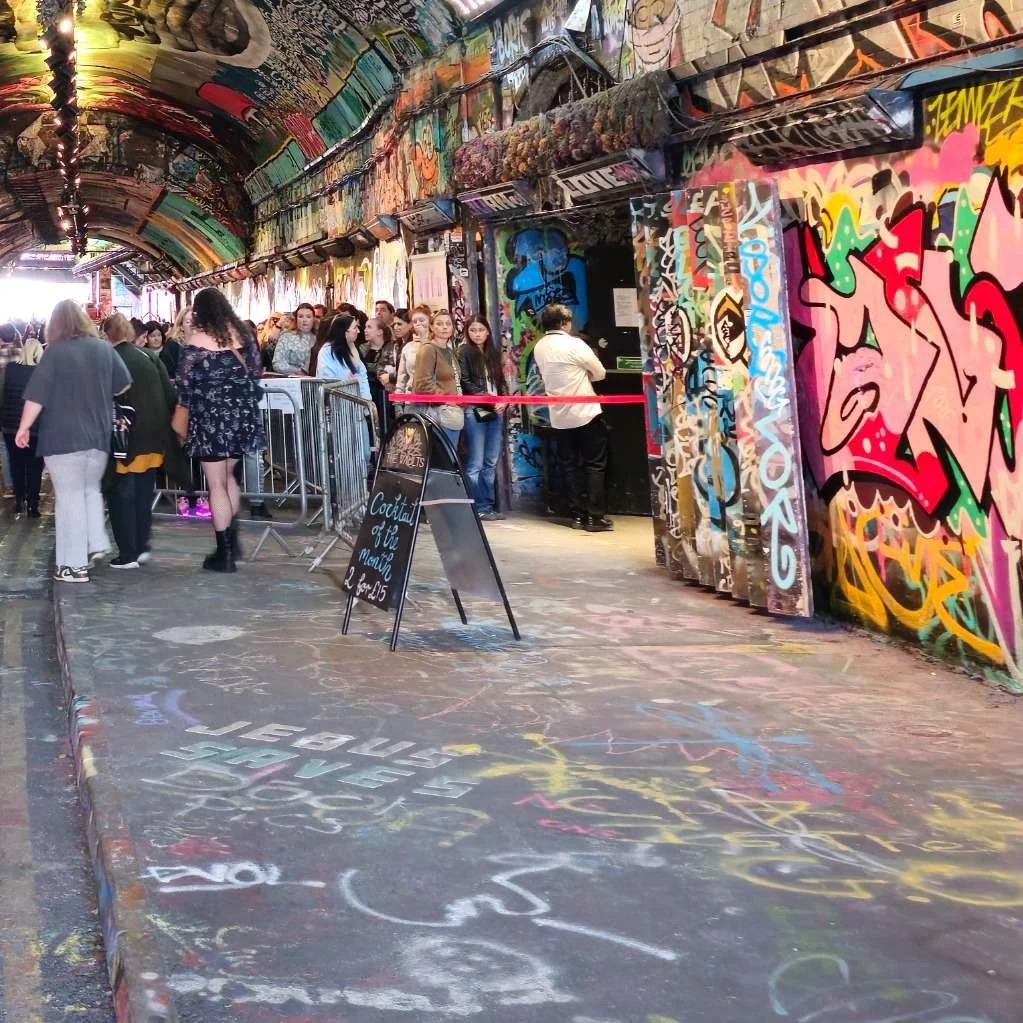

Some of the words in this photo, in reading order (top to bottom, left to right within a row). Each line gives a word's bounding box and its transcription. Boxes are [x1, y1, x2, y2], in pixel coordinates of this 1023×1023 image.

[370, 491, 418, 526] Cocktail
[371, 520, 386, 549] of
[383, 525, 400, 552] the
[343, 566, 355, 590] 2
[355, 573, 371, 596] for
[368, 584, 388, 602] £15
